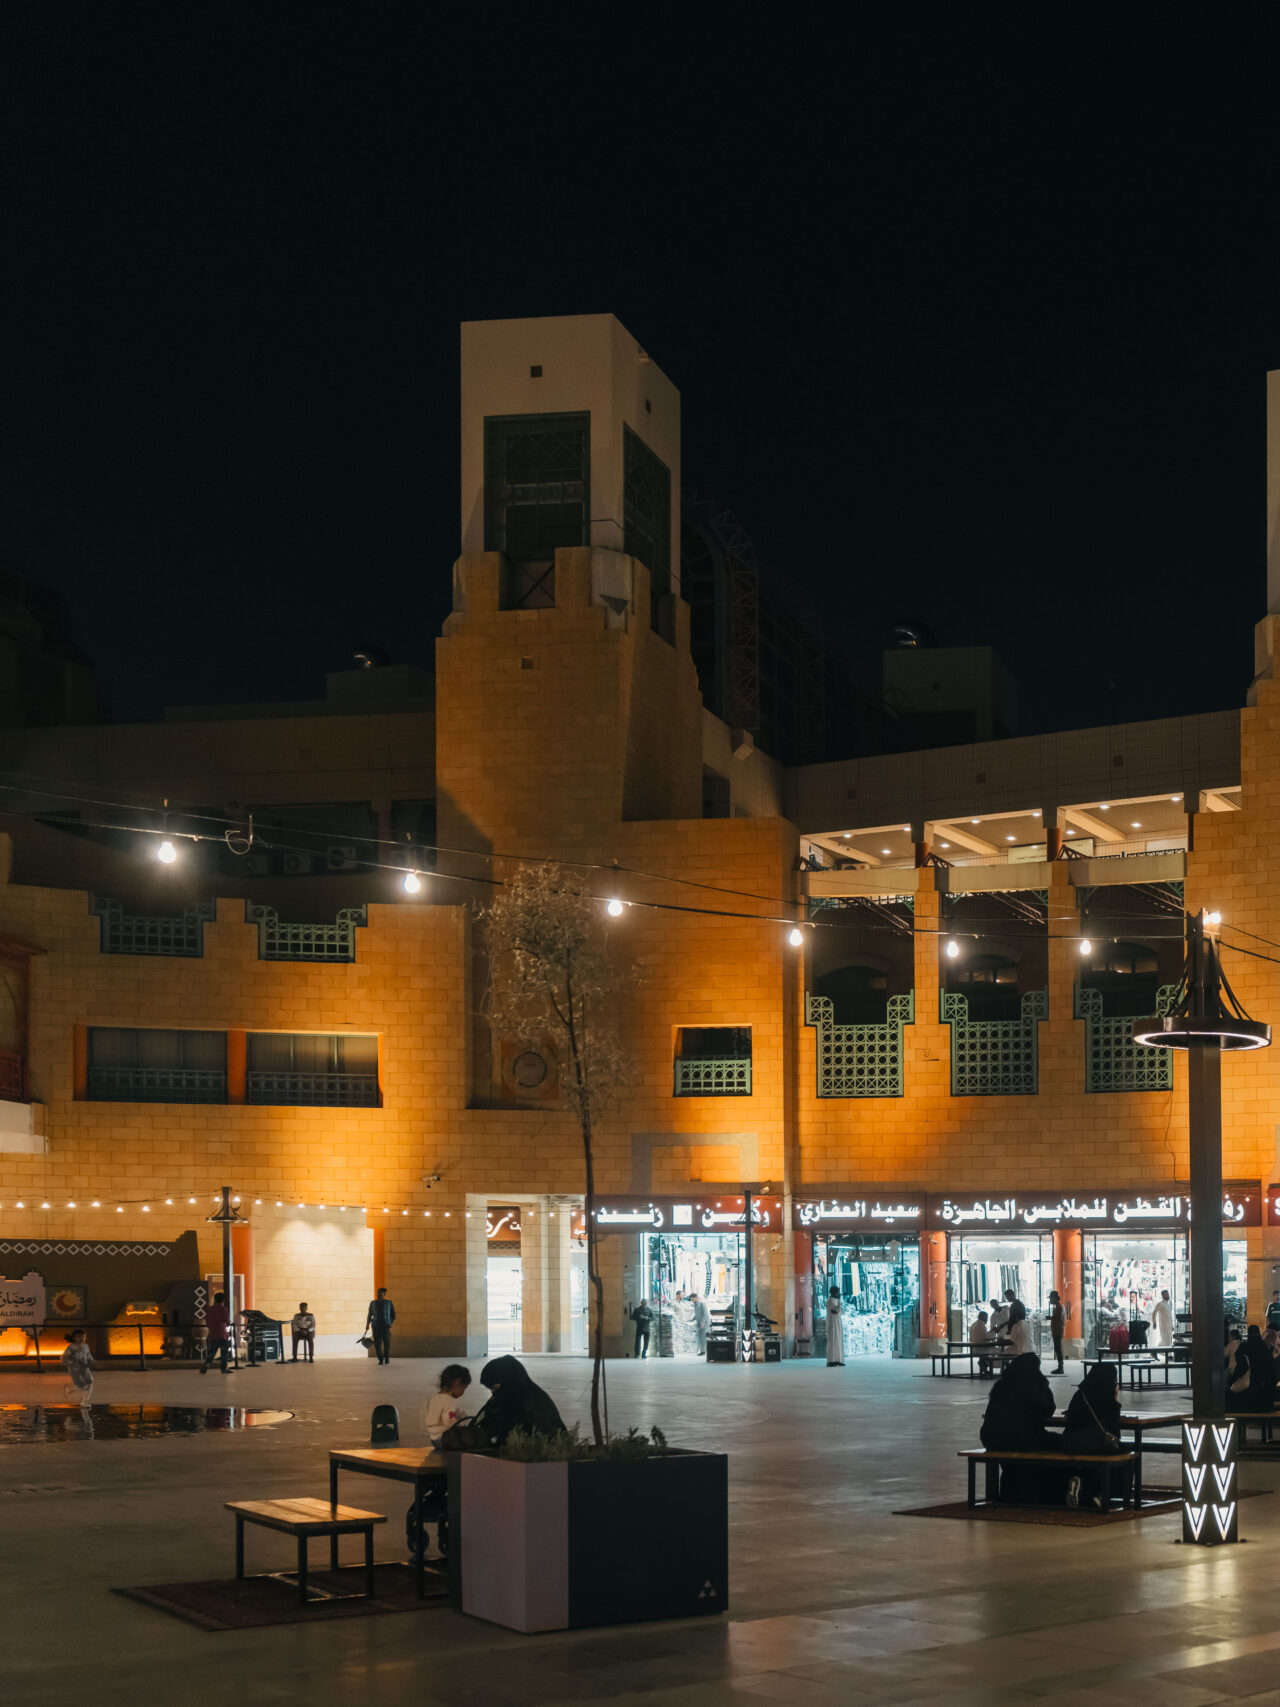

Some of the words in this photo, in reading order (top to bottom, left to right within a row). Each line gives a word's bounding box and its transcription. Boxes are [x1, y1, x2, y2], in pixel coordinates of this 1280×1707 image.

[870, 1201, 919, 1223] سعيد
[942, 1199, 1016, 1225] الجاهزة
[1023, 1198, 1107, 1224] للملابس
[1113, 1197, 1181, 1223] القطن
